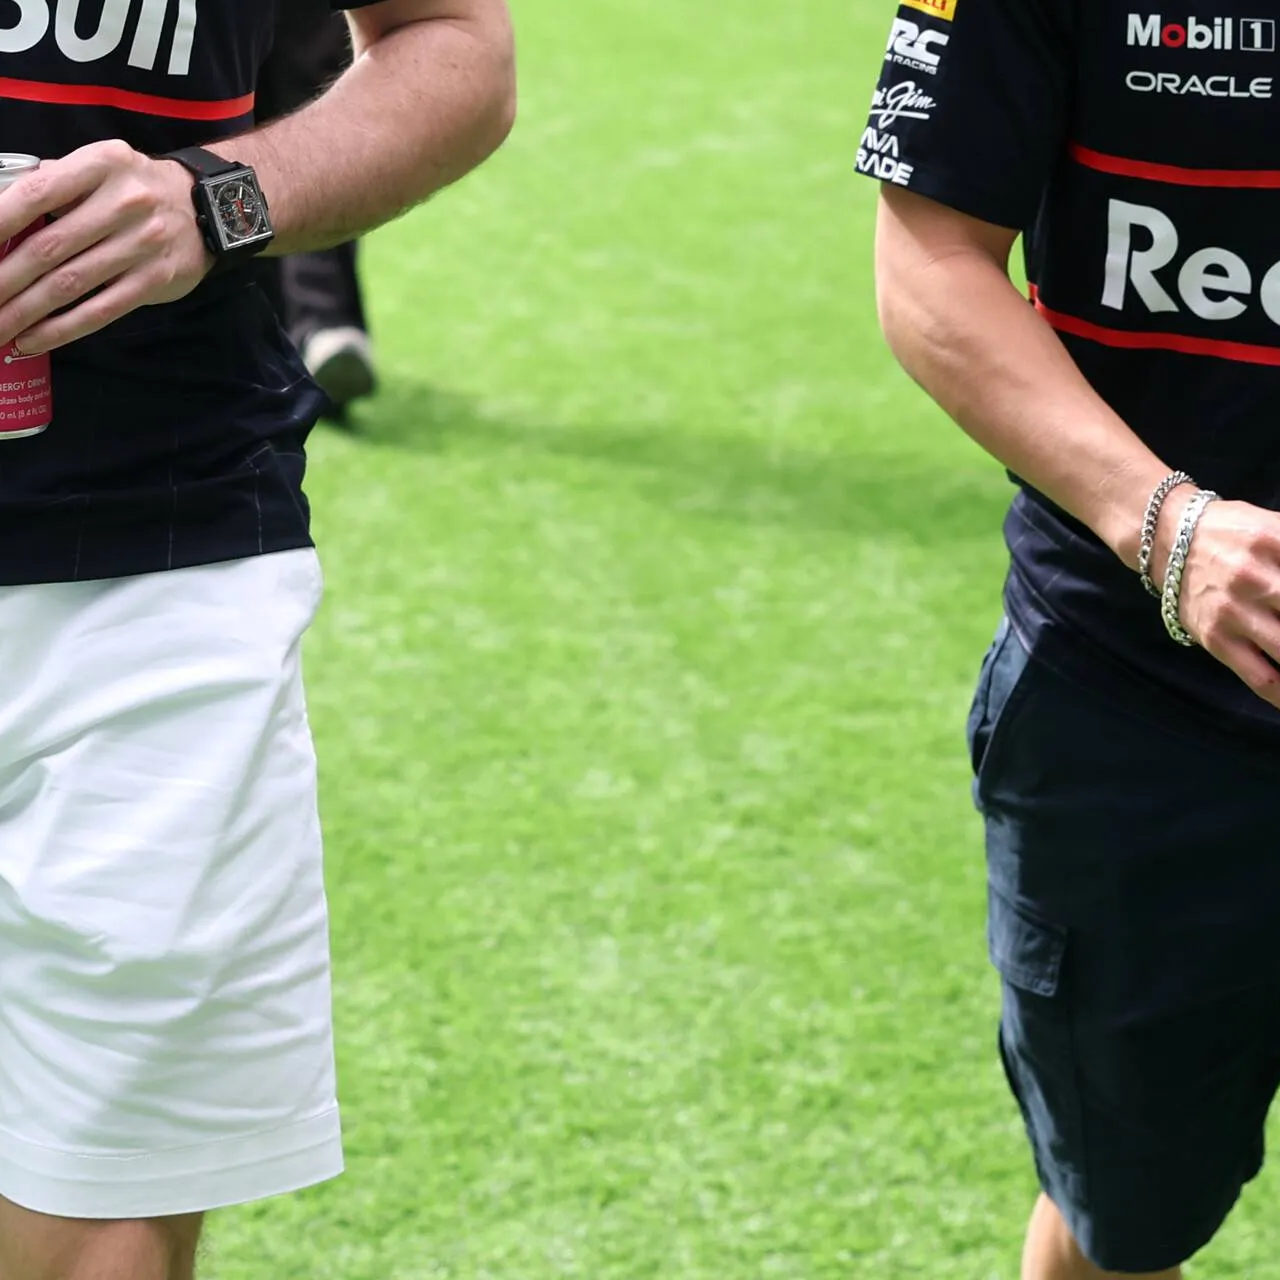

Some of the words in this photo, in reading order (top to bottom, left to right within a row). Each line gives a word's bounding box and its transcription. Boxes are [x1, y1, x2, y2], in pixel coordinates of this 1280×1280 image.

[1126, 14, 1233, 51] Mobil
[892, 55, 938, 76] RACING
[1126, 71, 1273, 98] ORACLE
